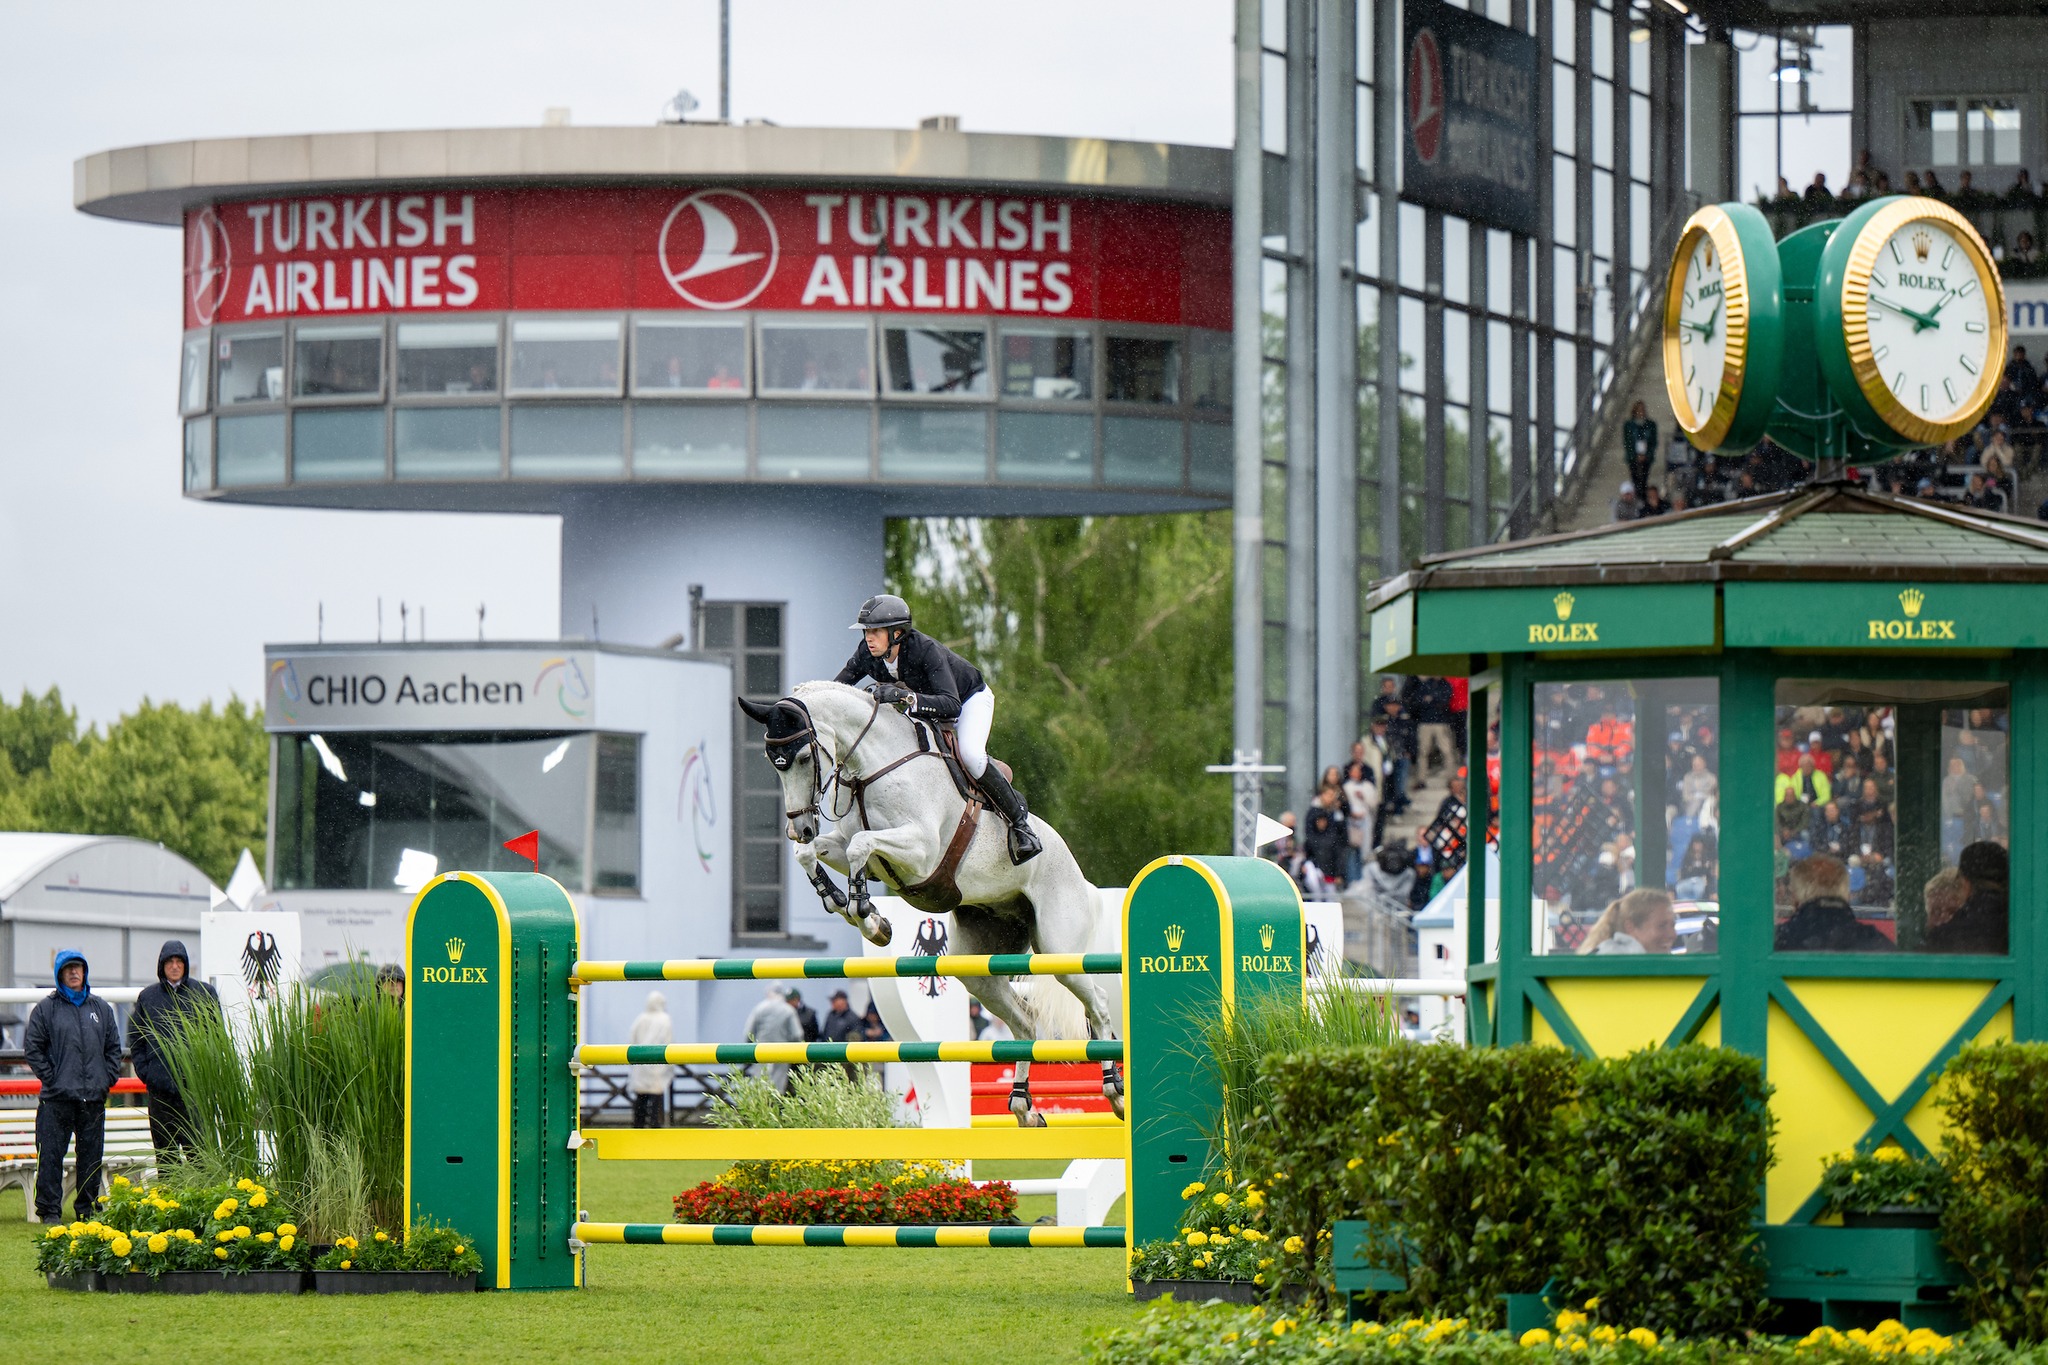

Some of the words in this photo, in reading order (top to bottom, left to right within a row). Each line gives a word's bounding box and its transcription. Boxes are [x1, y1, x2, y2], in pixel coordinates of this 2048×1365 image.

[247, 195, 475, 255] TURKISH
[805, 194, 1072, 252] TURKISH
[245, 255, 480, 315] AIRLINES
[801, 254, 1074, 313] AIRLINES
[1899, 273, 1946, 291] ROLEX
[1528, 623, 1599, 643] ROLEX
[1867, 620, 1956, 640] ROLEX
[307, 675, 386, 706] CHIO
[395, 673, 523, 705] Aachen
[1140, 955, 1209, 973] ROLEX
[1241, 955, 1293, 972] ROLEX
[422, 967, 488, 983] ROLEX
